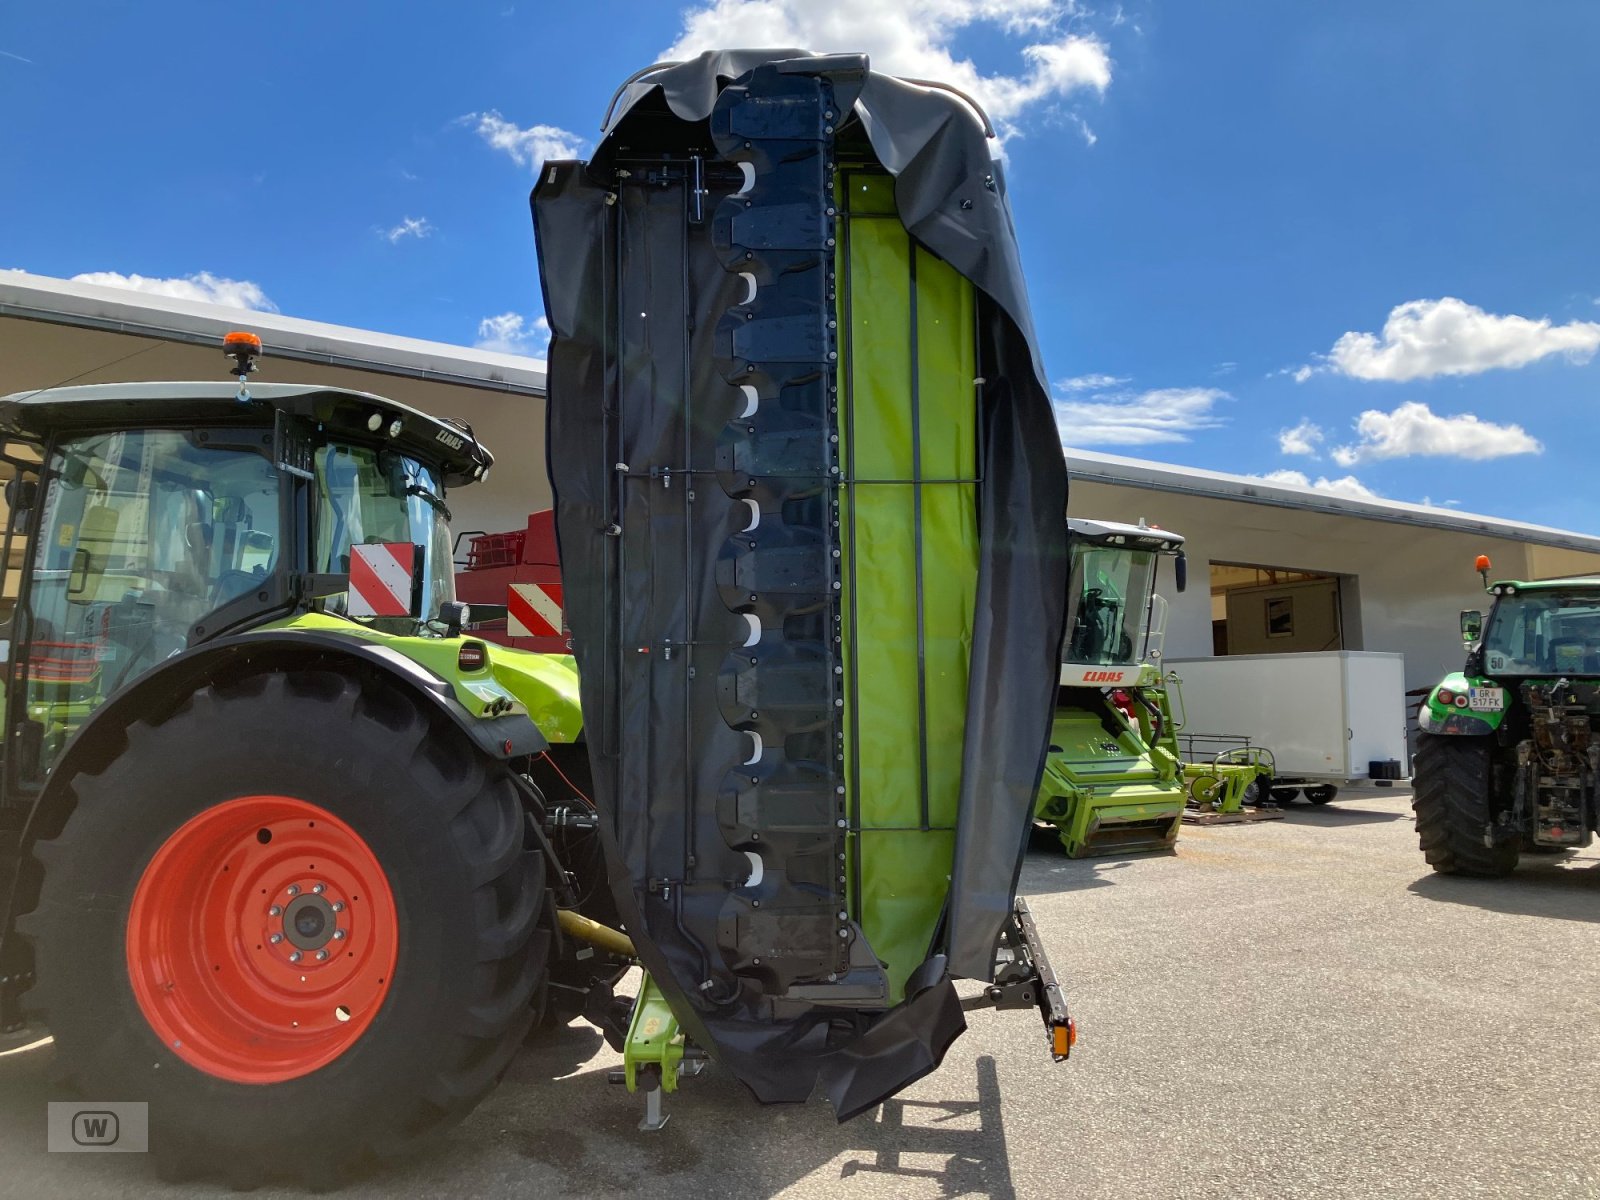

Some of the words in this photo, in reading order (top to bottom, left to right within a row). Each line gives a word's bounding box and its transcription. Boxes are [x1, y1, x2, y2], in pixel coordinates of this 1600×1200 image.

[435, 429, 464, 450] CLAAS
[1490, 657, 1504, 669] 50
[1082, 671, 1124, 682] CLAAS
[1479, 689, 1490, 698] GR
[1472, 698, 1487, 706] 517
[1488, 698, 1500, 706] FK
